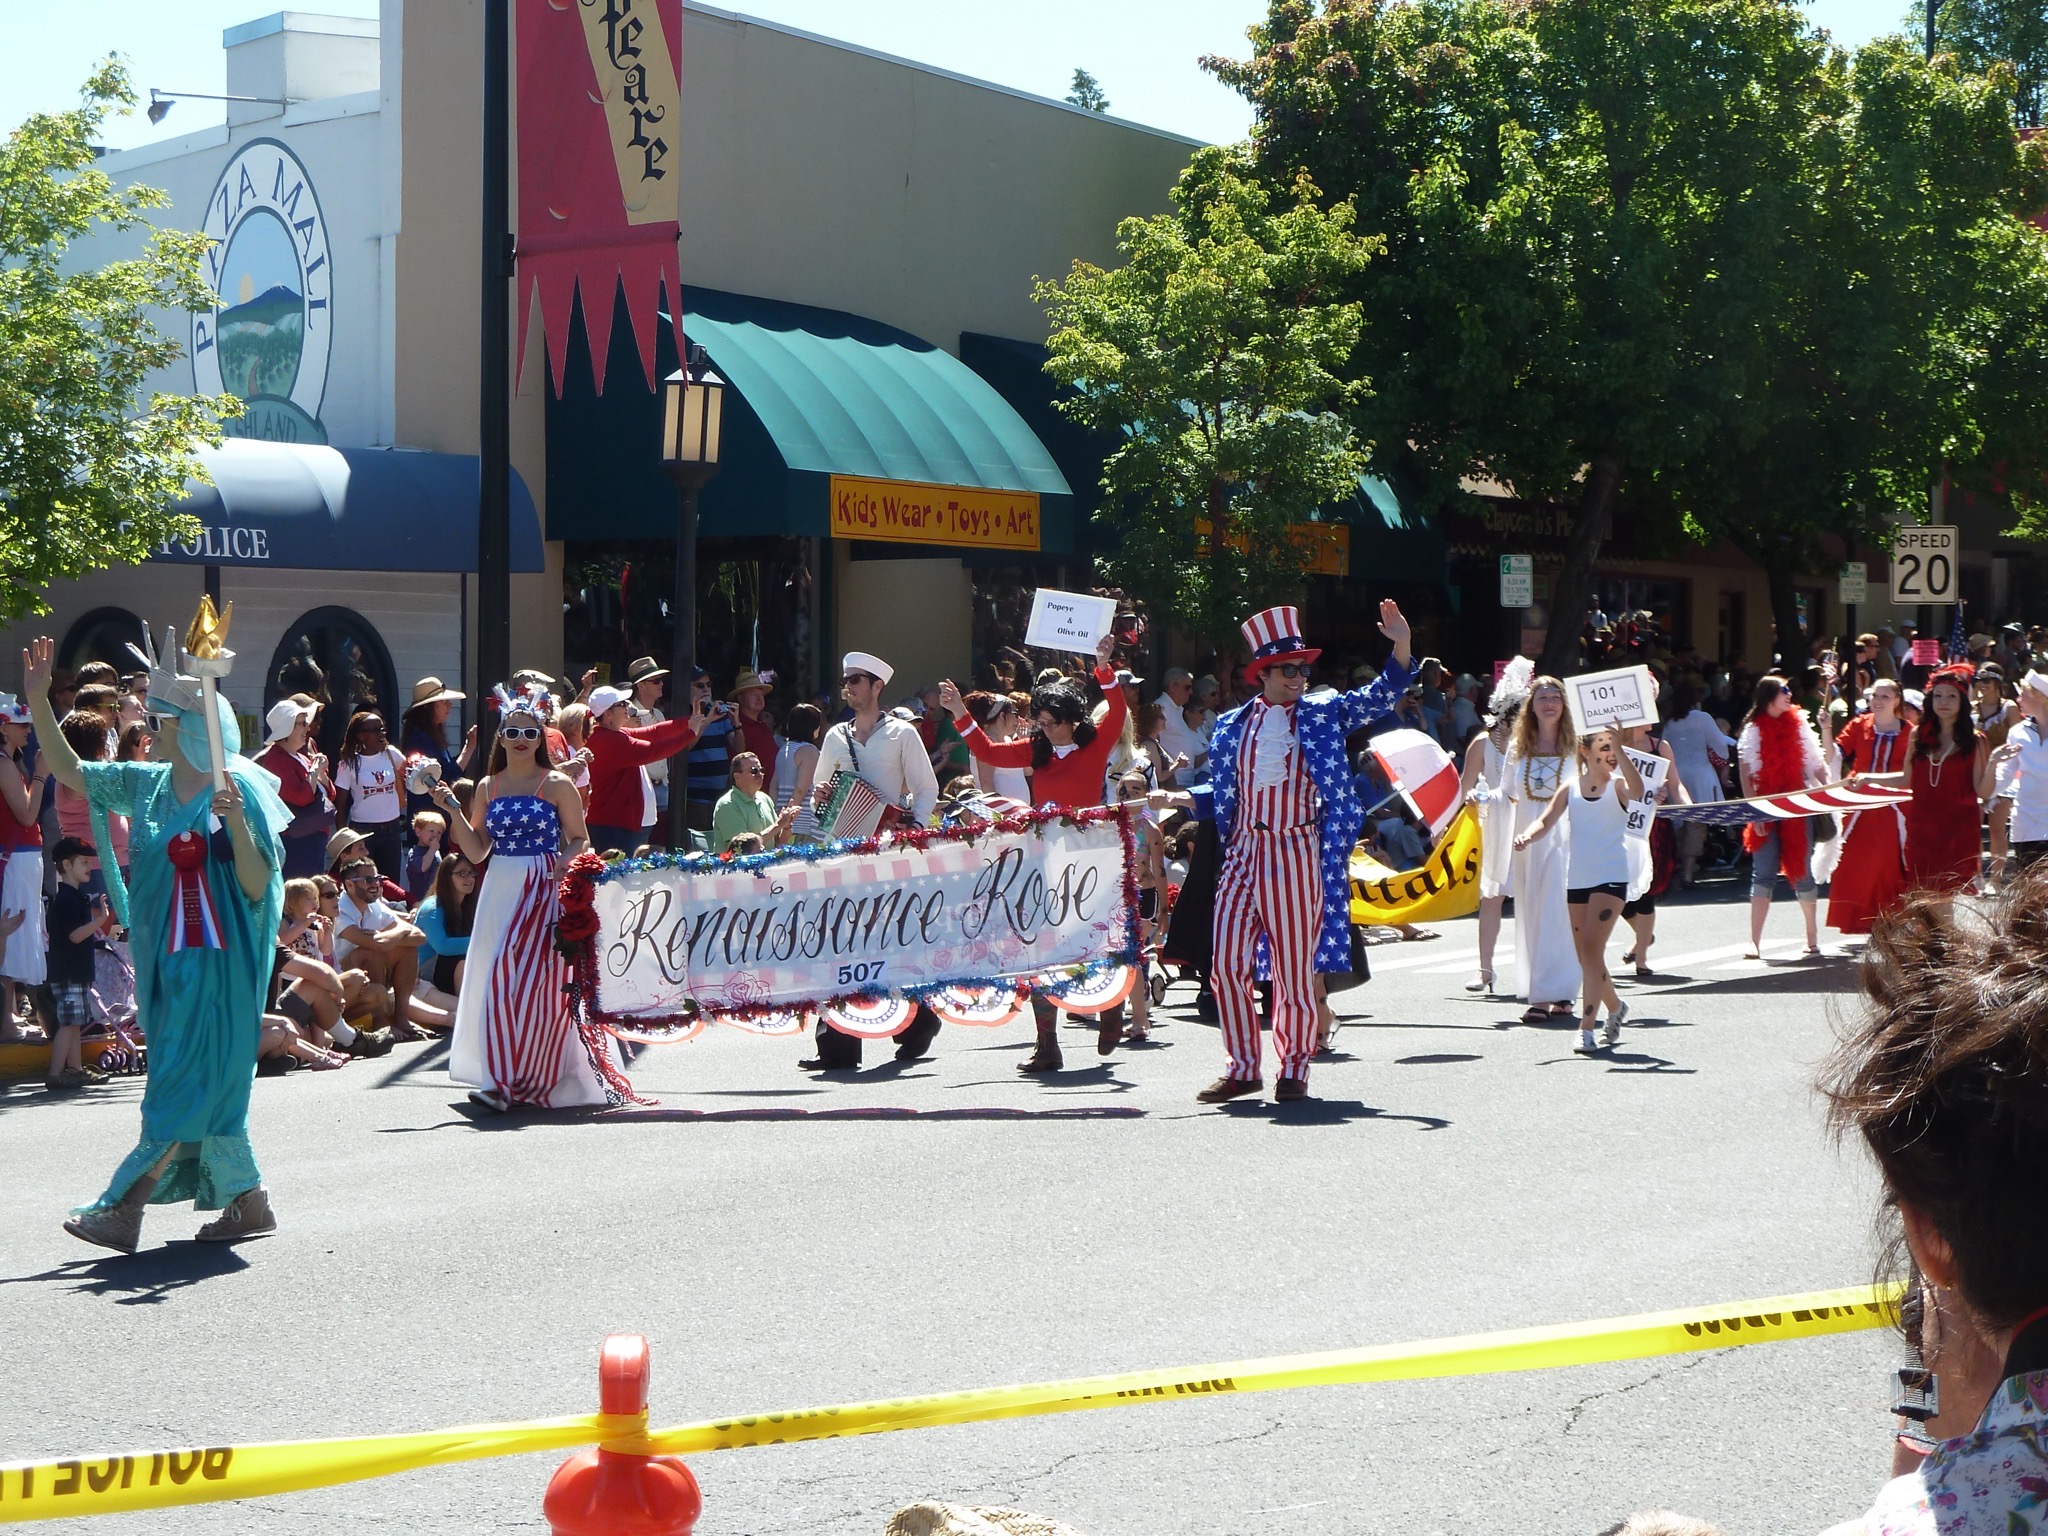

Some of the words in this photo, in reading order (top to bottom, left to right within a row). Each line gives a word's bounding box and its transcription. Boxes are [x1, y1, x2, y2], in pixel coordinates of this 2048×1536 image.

[582, 0, 668, 183] peare
[271, 157, 327, 331] MALL
[226, 410, 297, 443] SHLAND
[838, 490, 878, 528] Kids
[882, 496, 932, 529] Wear
[947, 501, 990, 537] Toys
[1005, 505, 1034, 537] Art
[1899, 534, 1951, 549] SPEED
[1898, 554, 1950, 595] 20
[1047, 602, 1074, 613] Popeye
[1057, 627, 1076, 637] Olive
[1078, 629, 1089, 638] Oil
[1586, 701, 1640, 718] DALMATIONS
[1590, 685, 1616, 701] 101
[1350, 841, 1478, 904] ntals
[607, 881, 944, 986] Renaissance
[961, 846, 1098, 945] Rose
[838, 961, 885, 985] 507
